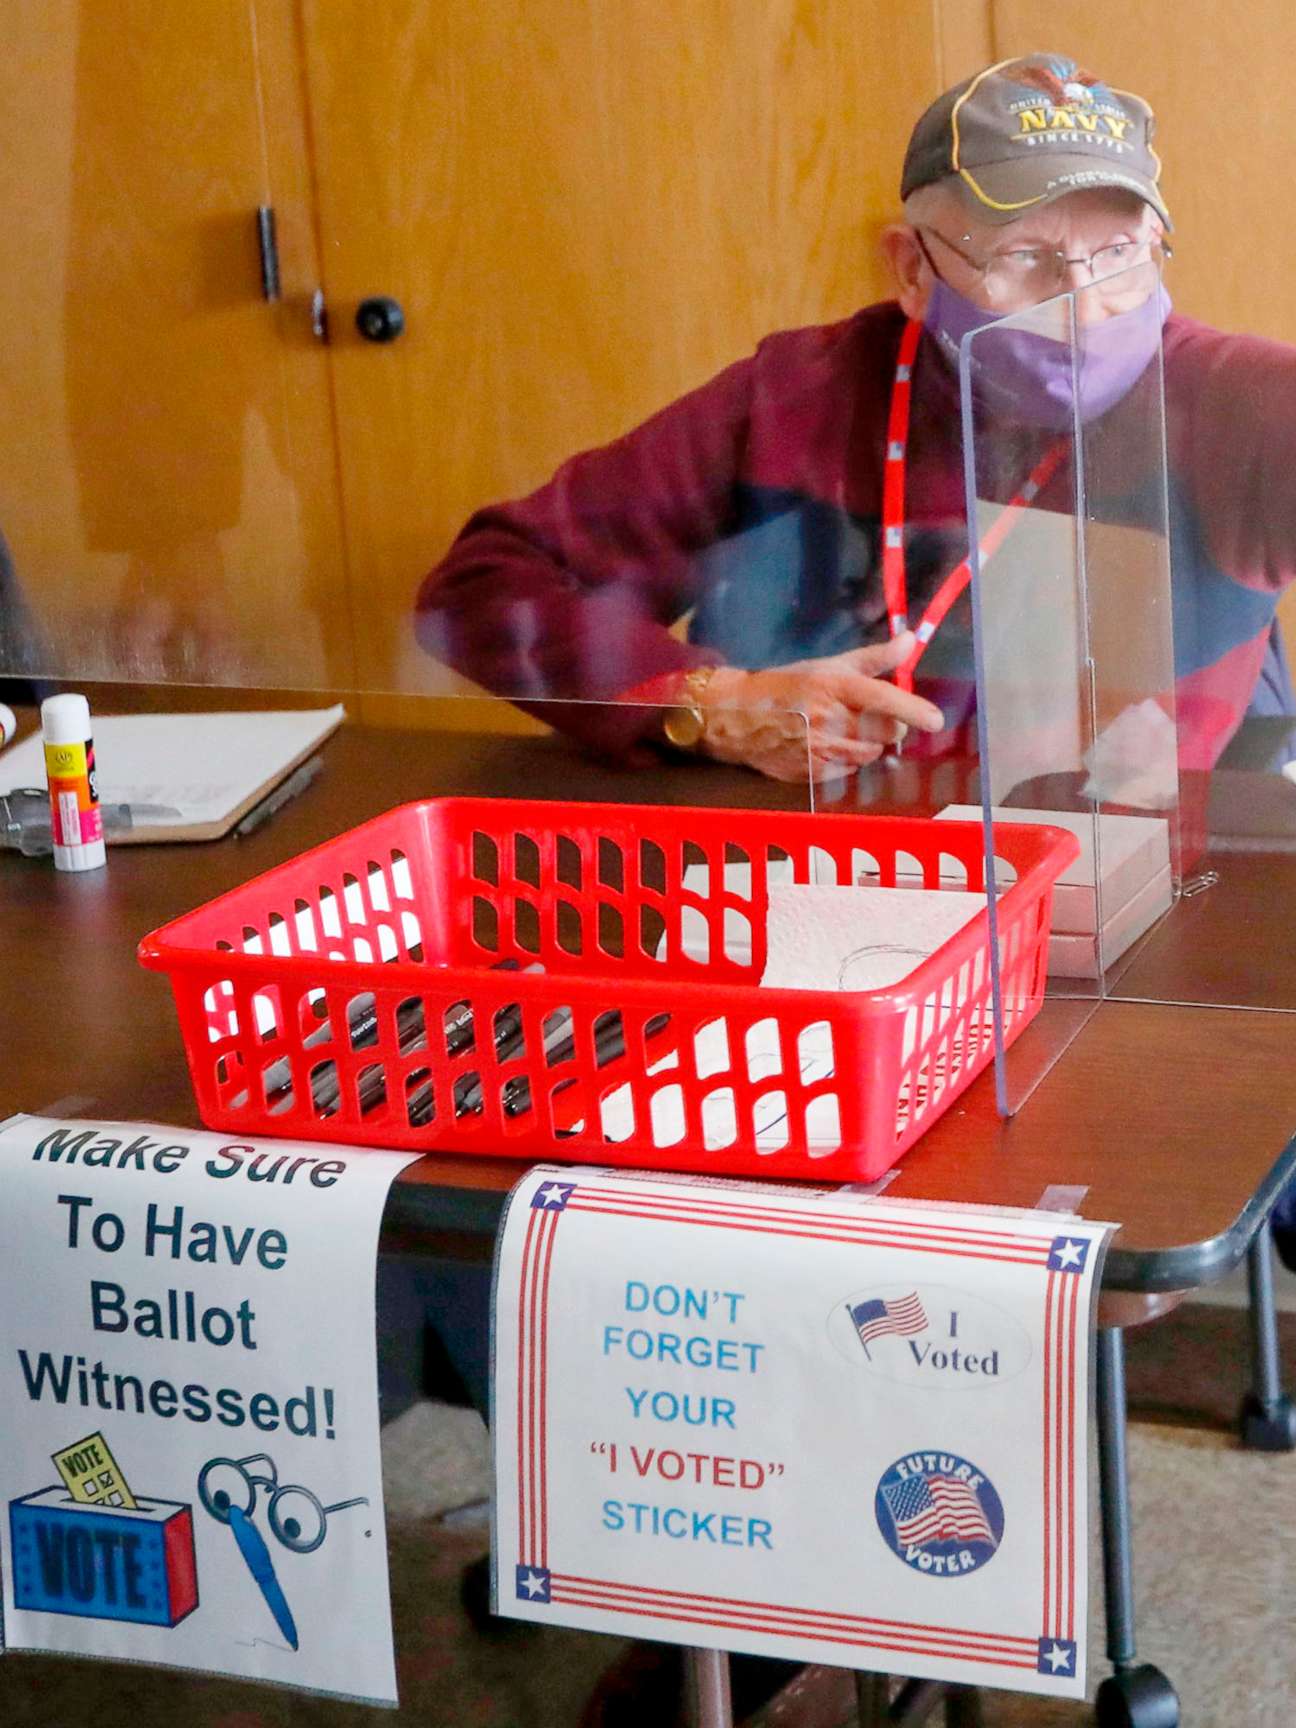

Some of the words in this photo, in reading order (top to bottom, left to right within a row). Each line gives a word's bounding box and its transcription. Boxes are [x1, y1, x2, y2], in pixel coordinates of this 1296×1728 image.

[1018, 108, 1126, 139] NAVY
[1027, 132, 1079, 146] SINCE
[32, 1128, 190, 1174] Make
[205, 1144, 347, 1189] Sure
[57, 1194, 126, 1253] To
[145, 1203, 289, 1271] Have
[90, 1279, 258, 1350] Ballot
[624, 1280, 746, 1324] DON’T
[948, 1310, 960, 1338] I
[602, 1325, 766, 1374] FORGET
[908, 1339, 1000, 1377] Voted
[17, 1349, 337, 1440] Witnessed!
[624, 1386, 738, 1430] YOUR
[61, 1443, 105, 1479] VOTE
[895, 1455, 986, 1490] FUTURE
[601, 1500, 774, 1550] STICKER
[34, 1520, 147, 1610] VOTE
[903, 1543, 977, 1573] VOTER
